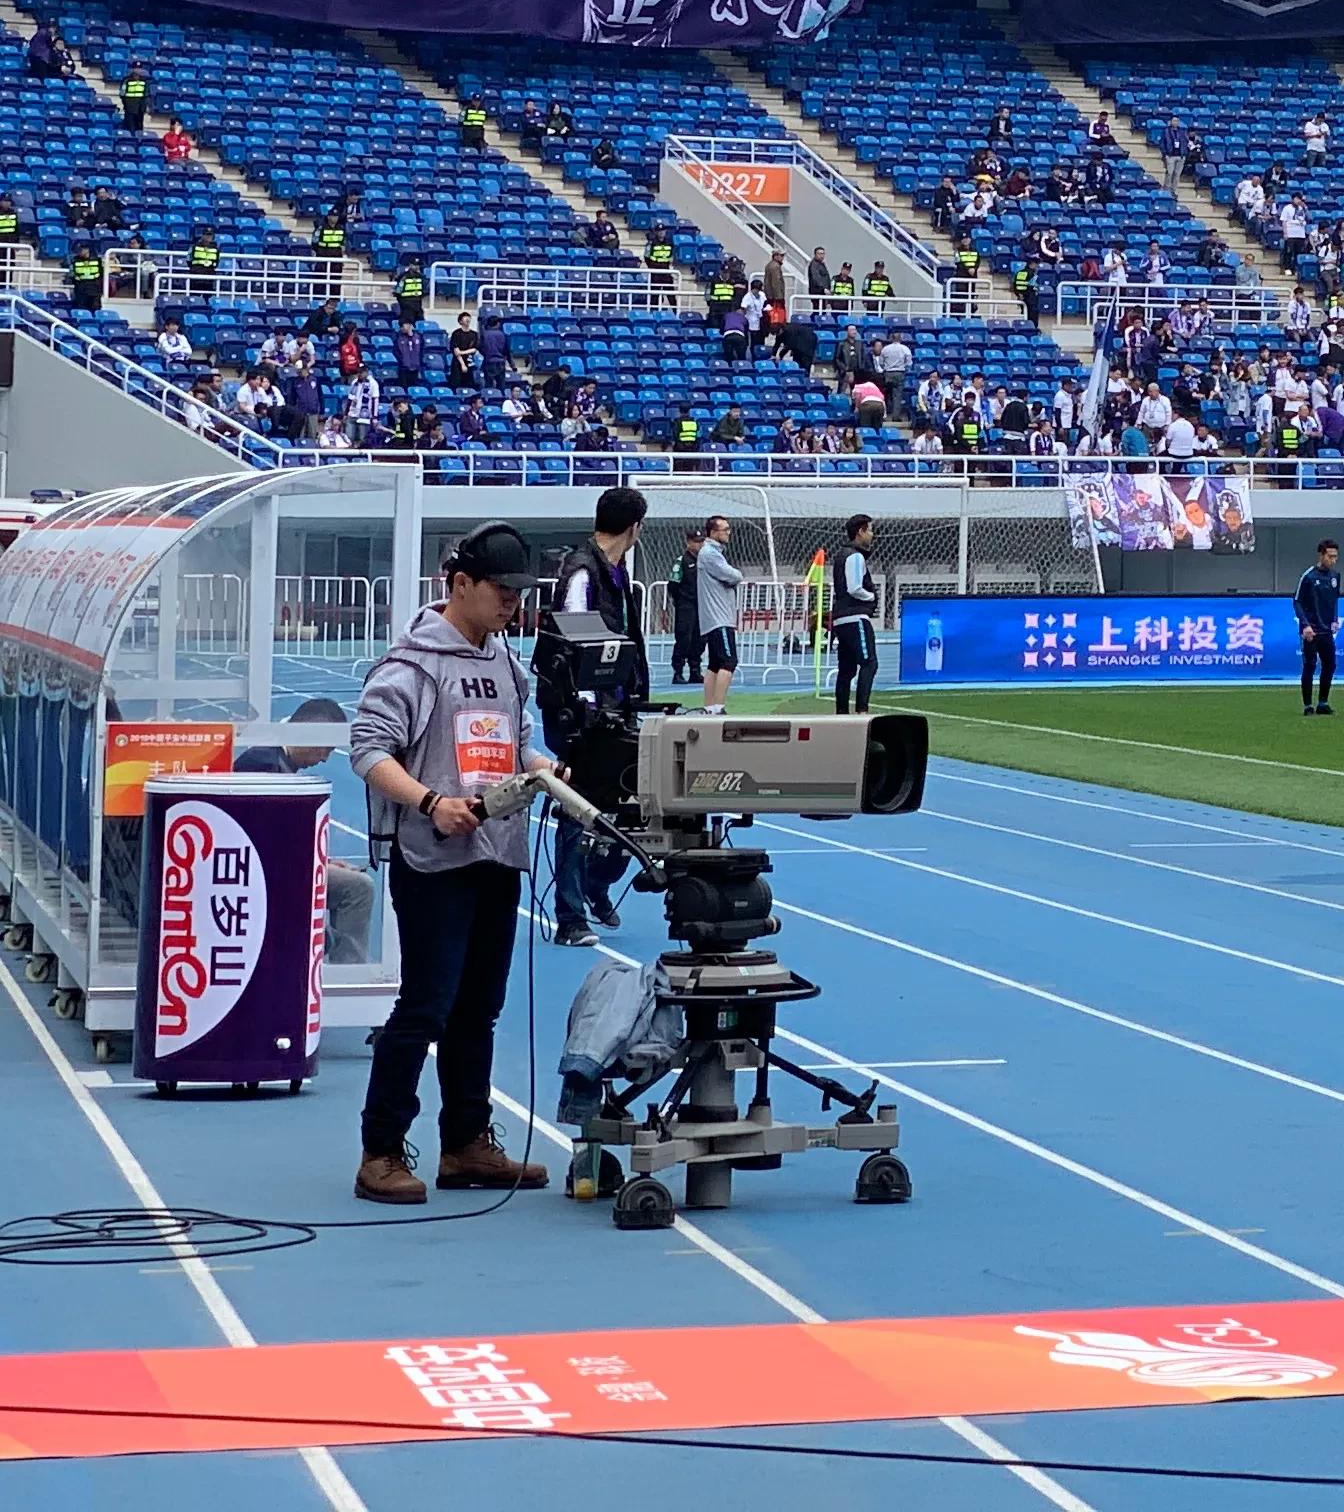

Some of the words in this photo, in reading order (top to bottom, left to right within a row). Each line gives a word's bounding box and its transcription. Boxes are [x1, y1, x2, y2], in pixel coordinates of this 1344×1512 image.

[1088, 615, 1265, 652] 上科投资
[606, 645, 616, 659] 3
[1088, 655, 1161, 666] SHANGKE
[1169, 654, 1265, 666] INVESTMENT
[461, 678, 498, 699] HB
[209, 845, 251, 986] 百岁山
